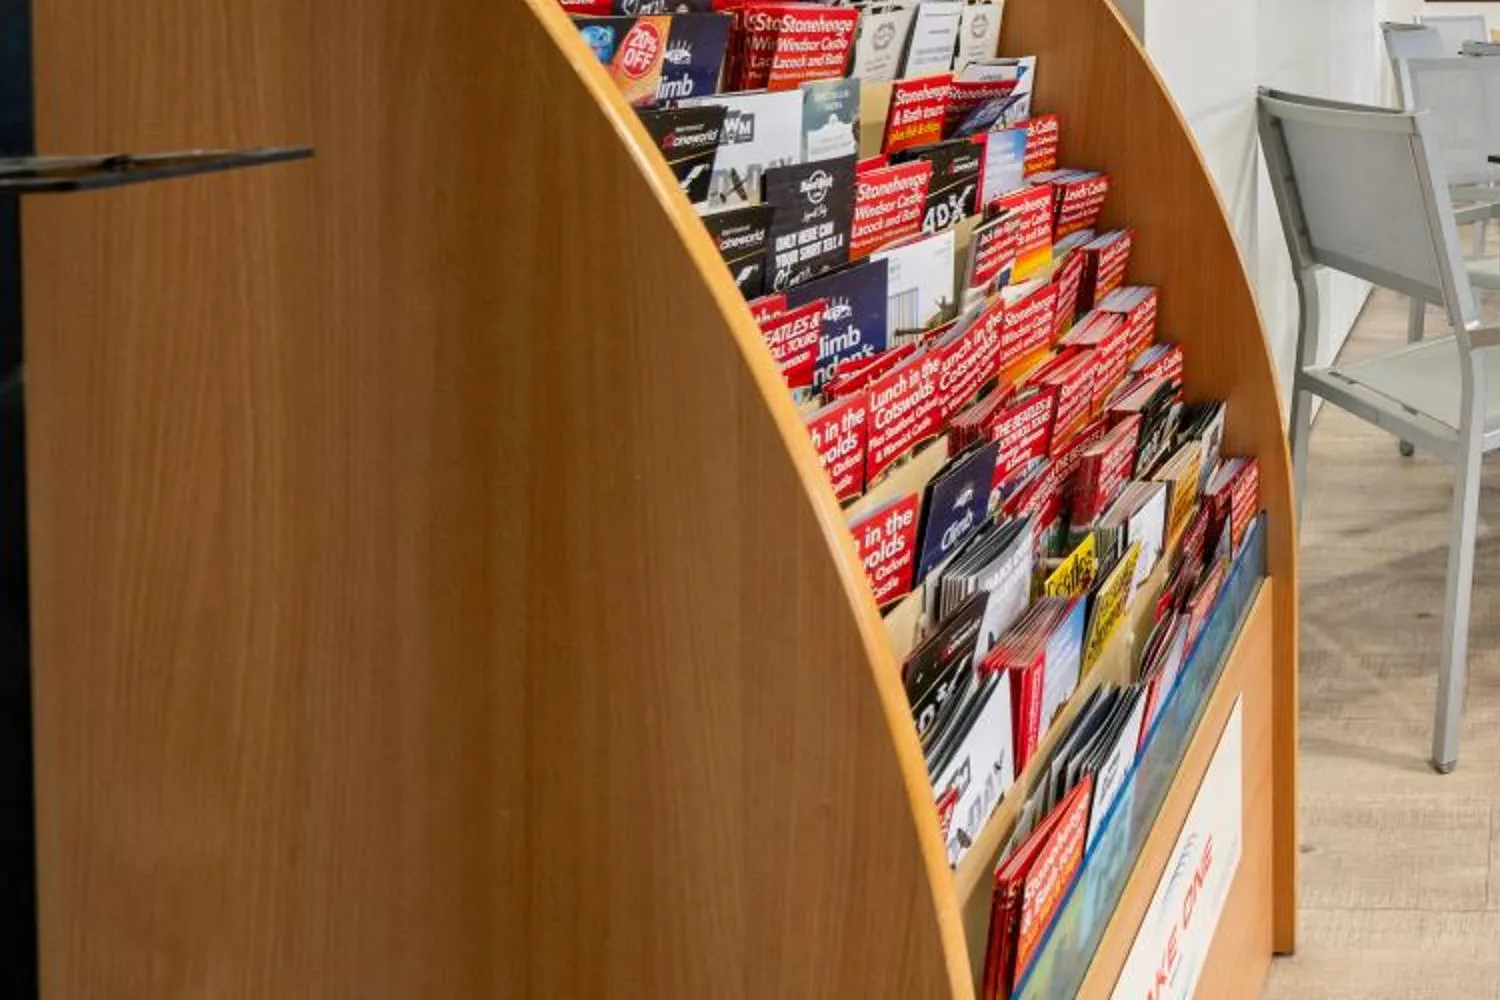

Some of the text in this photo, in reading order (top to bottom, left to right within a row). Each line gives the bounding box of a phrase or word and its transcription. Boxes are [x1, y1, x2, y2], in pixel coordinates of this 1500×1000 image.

[781, 13, 853, 36] Stonehenge
[624, 47, 653, 70] OFF
[777, 37, 820, 52] Windsor
[856, 171, 928, 202] Stonehenge
[765, 316, 809, 343] EATLES
[871, 358, 940, 412] Lunch in the
[875, 382, 935, 429] Cotswolds
[825, 407, 866, 442] in the
[865, 509, 914, 548] in the
